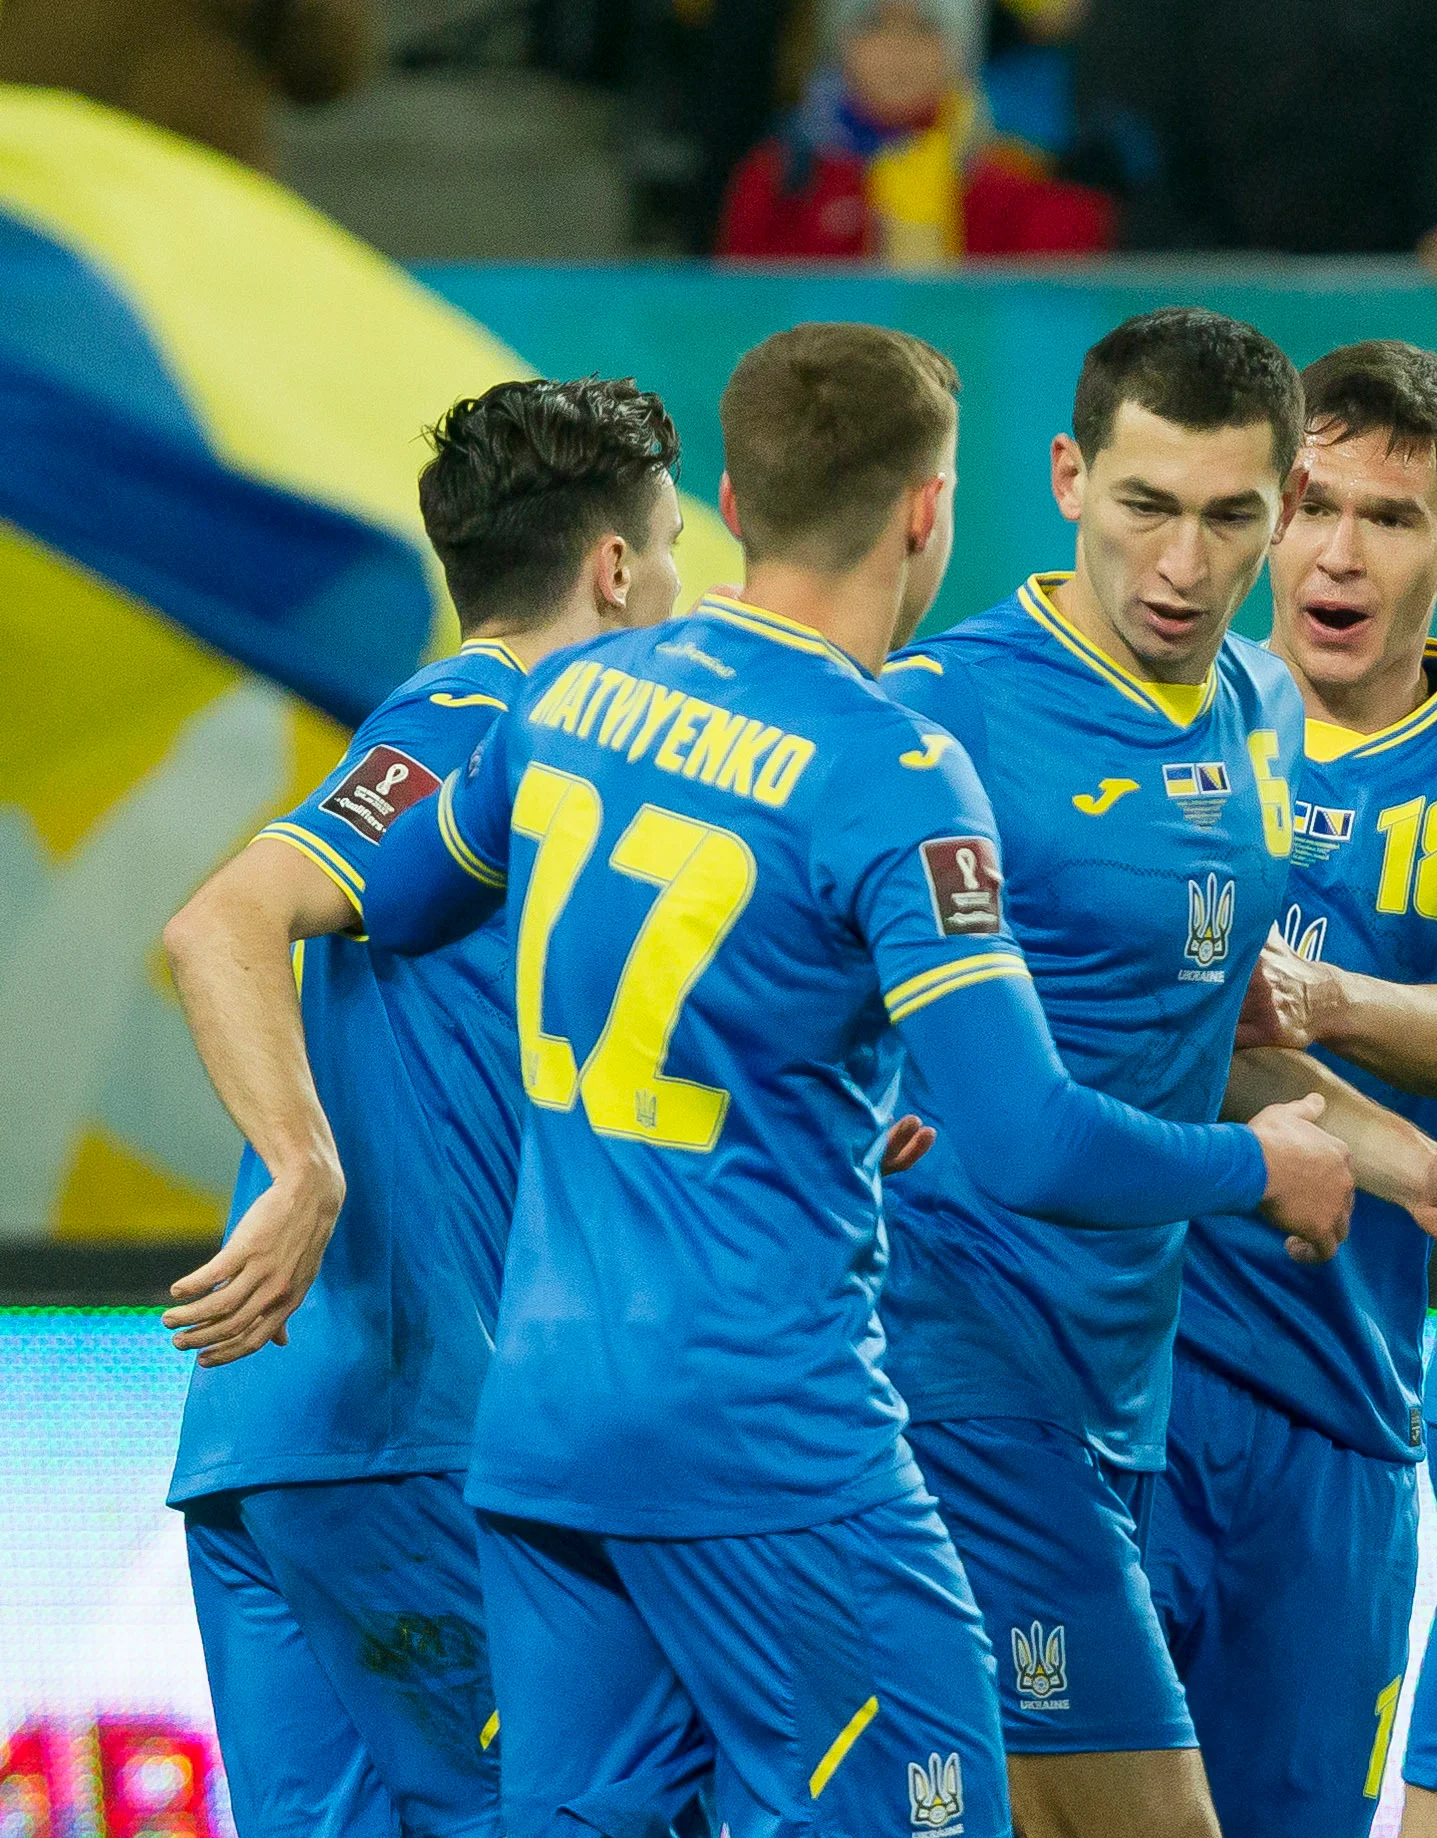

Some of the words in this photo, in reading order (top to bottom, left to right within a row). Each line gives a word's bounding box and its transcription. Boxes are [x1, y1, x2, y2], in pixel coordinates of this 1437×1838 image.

[1246, 728, 1294, 858] 6
[512, 760, 758, 1153] 22
[1020, 1699, 1070, 1710] UKRAINE
